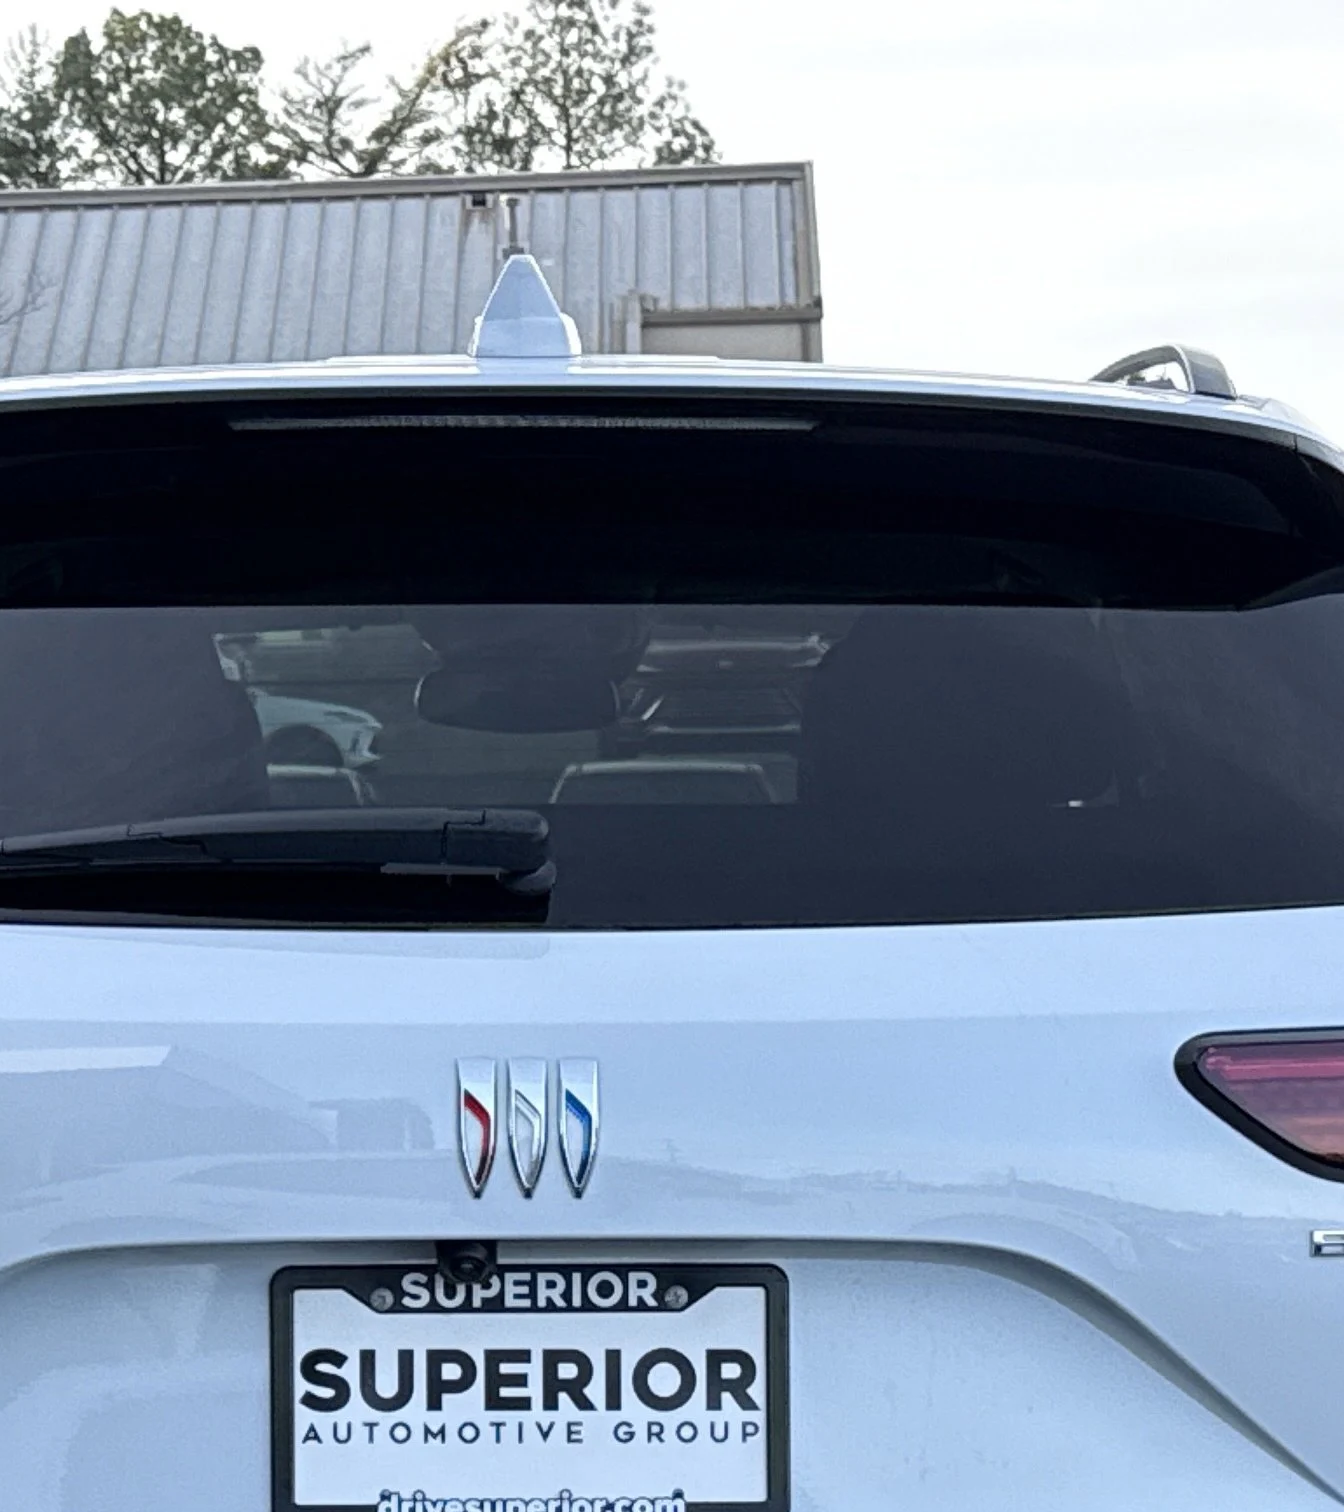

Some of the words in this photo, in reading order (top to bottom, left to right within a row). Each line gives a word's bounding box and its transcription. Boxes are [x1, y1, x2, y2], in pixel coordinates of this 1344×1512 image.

[400, 1272, 658, 1308] SUPERIOR
[299, 1347, 762, 1413] SUPERIOR
[301, 1421, 584, 1444] AUTOMOTIVE
[613, 1420, 761, 1444] GROUP
